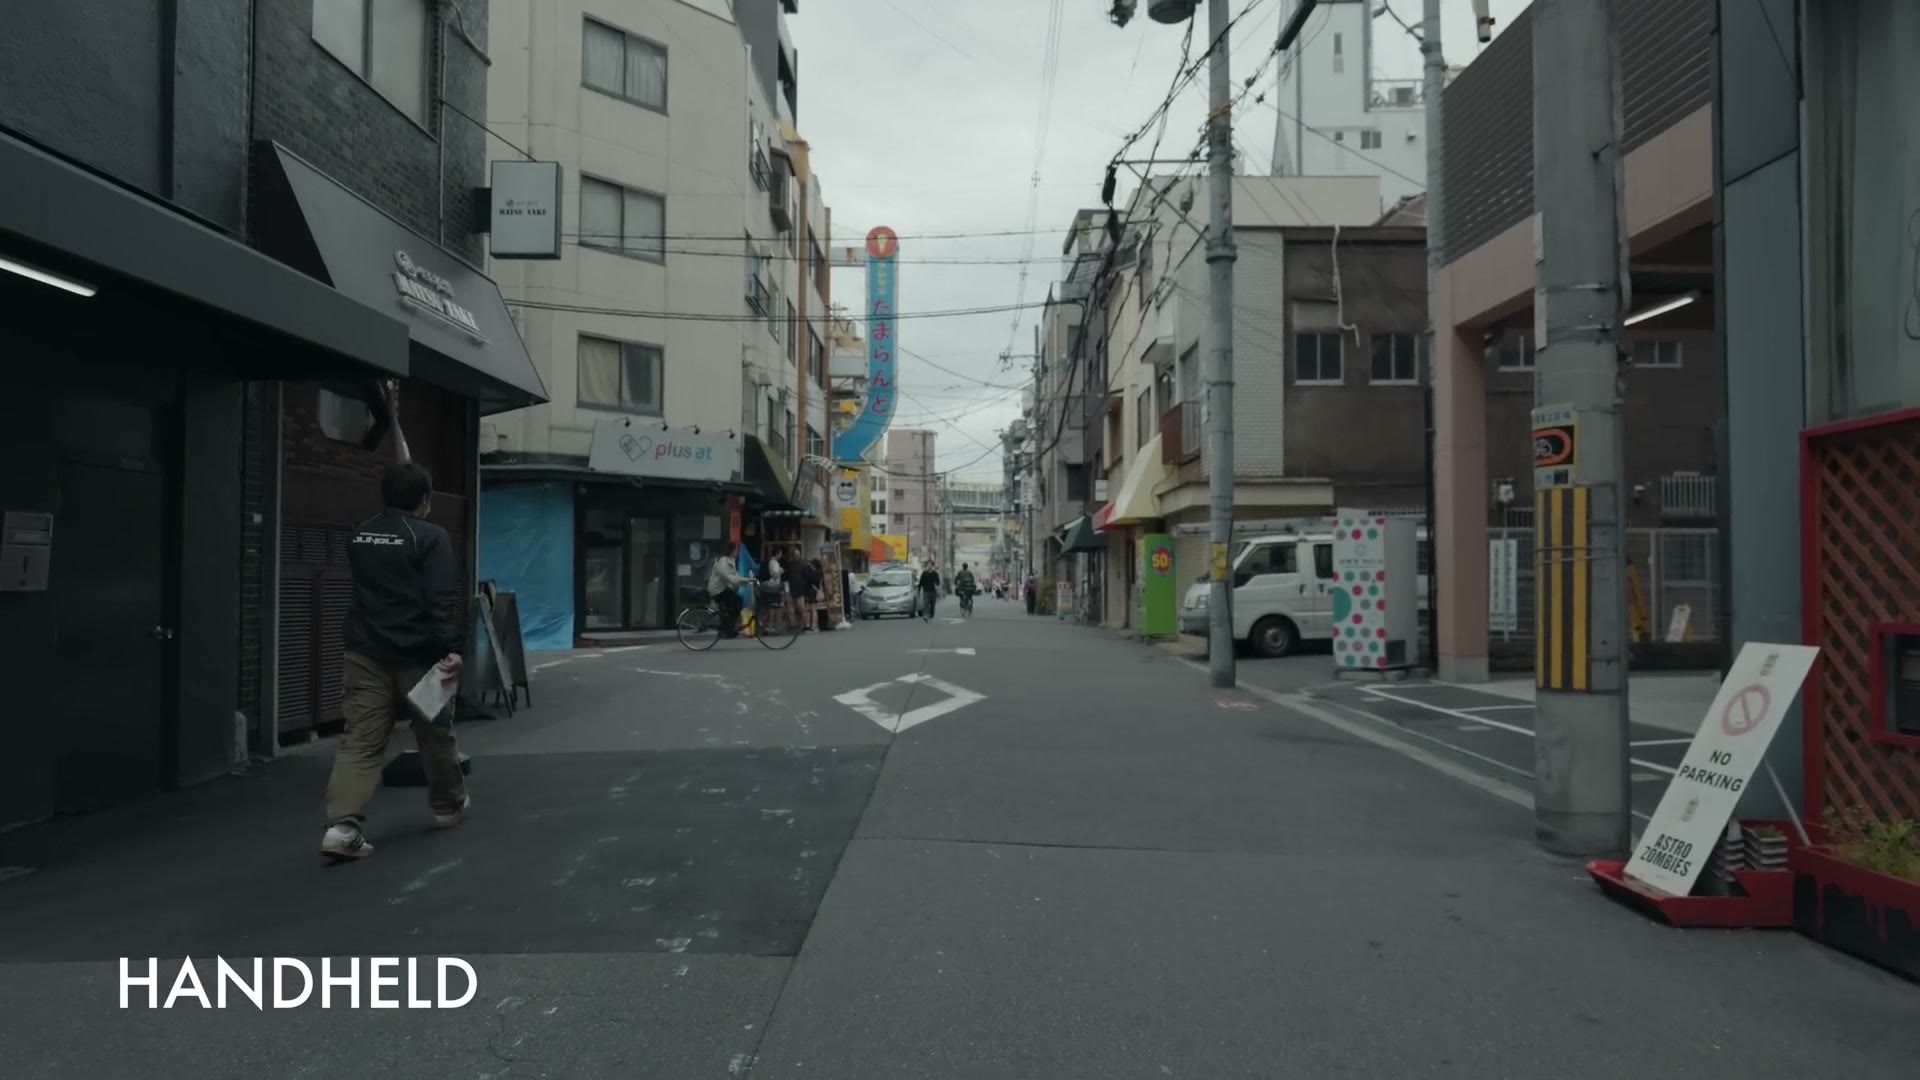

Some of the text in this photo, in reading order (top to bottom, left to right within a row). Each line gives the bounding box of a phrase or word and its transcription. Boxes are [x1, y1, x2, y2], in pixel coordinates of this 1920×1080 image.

[871, 299, 890, 415] たまらんど
[654, 440, 713, 461] plus at
[352, 535, 405, 546] JUNGLE
[1709, 749, 1732, 765] NO
[1679, 765, 1744, 793] PARKING
[1654, 834, 1693, 859] ASTRO
[1640, 846, 1692, 878] ZOMBIES
